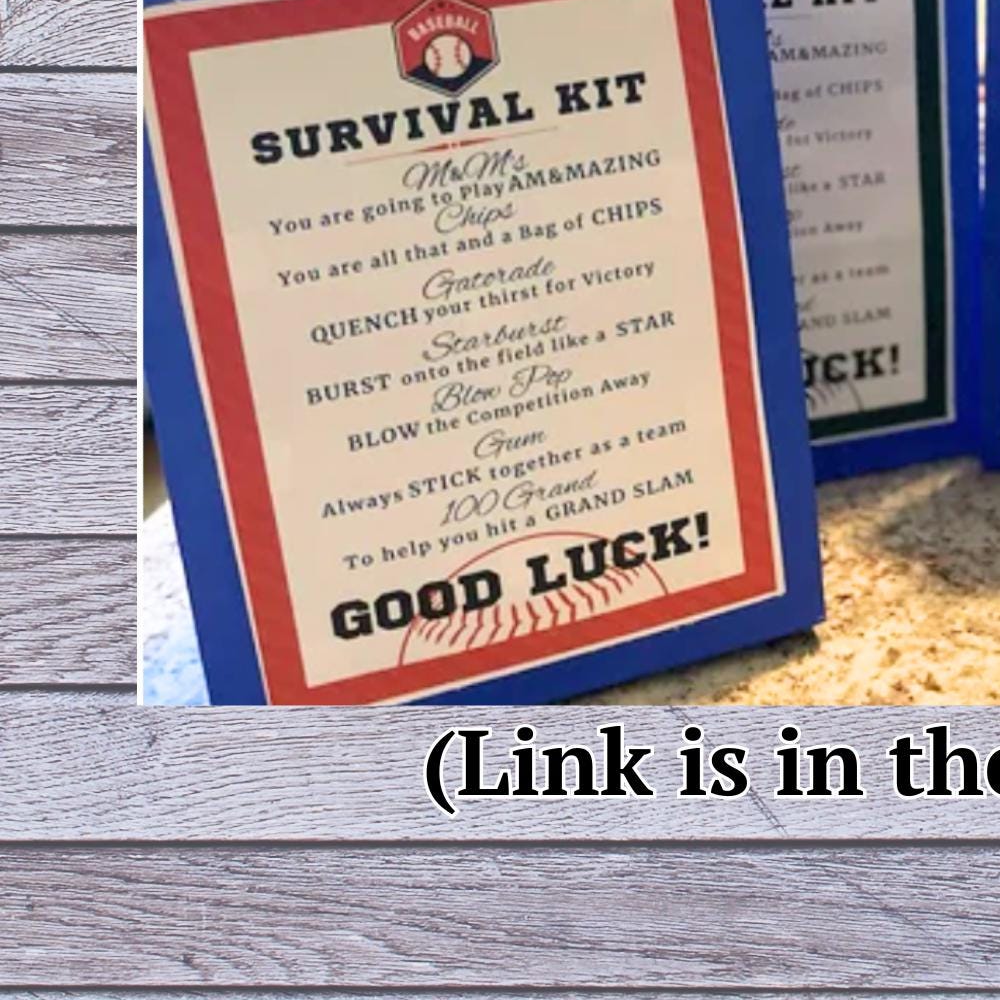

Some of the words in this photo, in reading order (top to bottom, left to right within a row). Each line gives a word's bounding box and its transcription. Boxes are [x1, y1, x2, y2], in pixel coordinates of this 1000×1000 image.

[408, 14, 480, 42] BASEBALL
[251, 90, 535, 165] SURVIVAL
[555, 72, 647, 115] KIT
[827, 79, 884, 97] CHIPS
[268, 216, 312, 236] You
[320, 206, 356, 226] are
[362, 196, 425, 223] going
[430, 190, 453, 206] to
[459, 180, 504, 202] Play
[508, 149, 662, 192] AM&MAZING
[402, 148, 531, 191] M&M's
[277, 268, 321, 288] You
[328, 259, 363, 277] are
[370, 250, 398, 268] all
[405, 241, 450, 263] that
[457, 231, 495, 254] and
[501, 229, 512, 244] a
[519, 220, 557, 243] Bag
[564, 214, 584, 232] of
[591, 197, 664, 225] CHIPS
[435, 200, 518, 234] Chips
[310, 308, 418, 346] QUENCH
[423, 301, 471, 325] your
[479, 285, 539, 308] thirst
[546, 278, 576, 295] for
[581, 259, 655, 286] Victory
[421, 256, 556, 300] Gatorade
[306, 374, 392, 407] BURST
[400, 363, 451, 386] onto
[457, 355, 490, 373] the
[498, 343, 545, 364] field
[552, 333, 589, 353] like
[595, 330, 606, 343] a
[615, 310, 676, 337] STAR
[422, 315, 567, 363] Starburst
[347, 421, 422, 453] BLOW
[426, 416, 460, 436] the
[466, 385, 595, 425] Competition
[600, 370, 651, 395] Away
[430, 382, 501, 414] Blow
[508, 364, 573, 398] Pop
[321, 489, 405, 518] Always
[407, 467, 482, 498] STICK
[488, 447, 583, 480] together
[589, 441, 612, 456] as
[618, 436, 631, 448] a
[637, 419, 688, 444] team
[473, 428, 547, 460] Gum
[343, 553, 374, 571] To
[381, 542, 433, 564] help
[438, 529, 479, 554] you
[485, 518, 517, 536] hit
[524, 515, 537, 528] a
[545, 487, 626, 522] GRAND
[632, 469, 695, 498] SLAM
[440, 494, 499, 527] 100
[503, 469, 598, 509] Grand
[330, 568, 502, 641] GOOD
[526, 511, 710, 596] LUCK!
